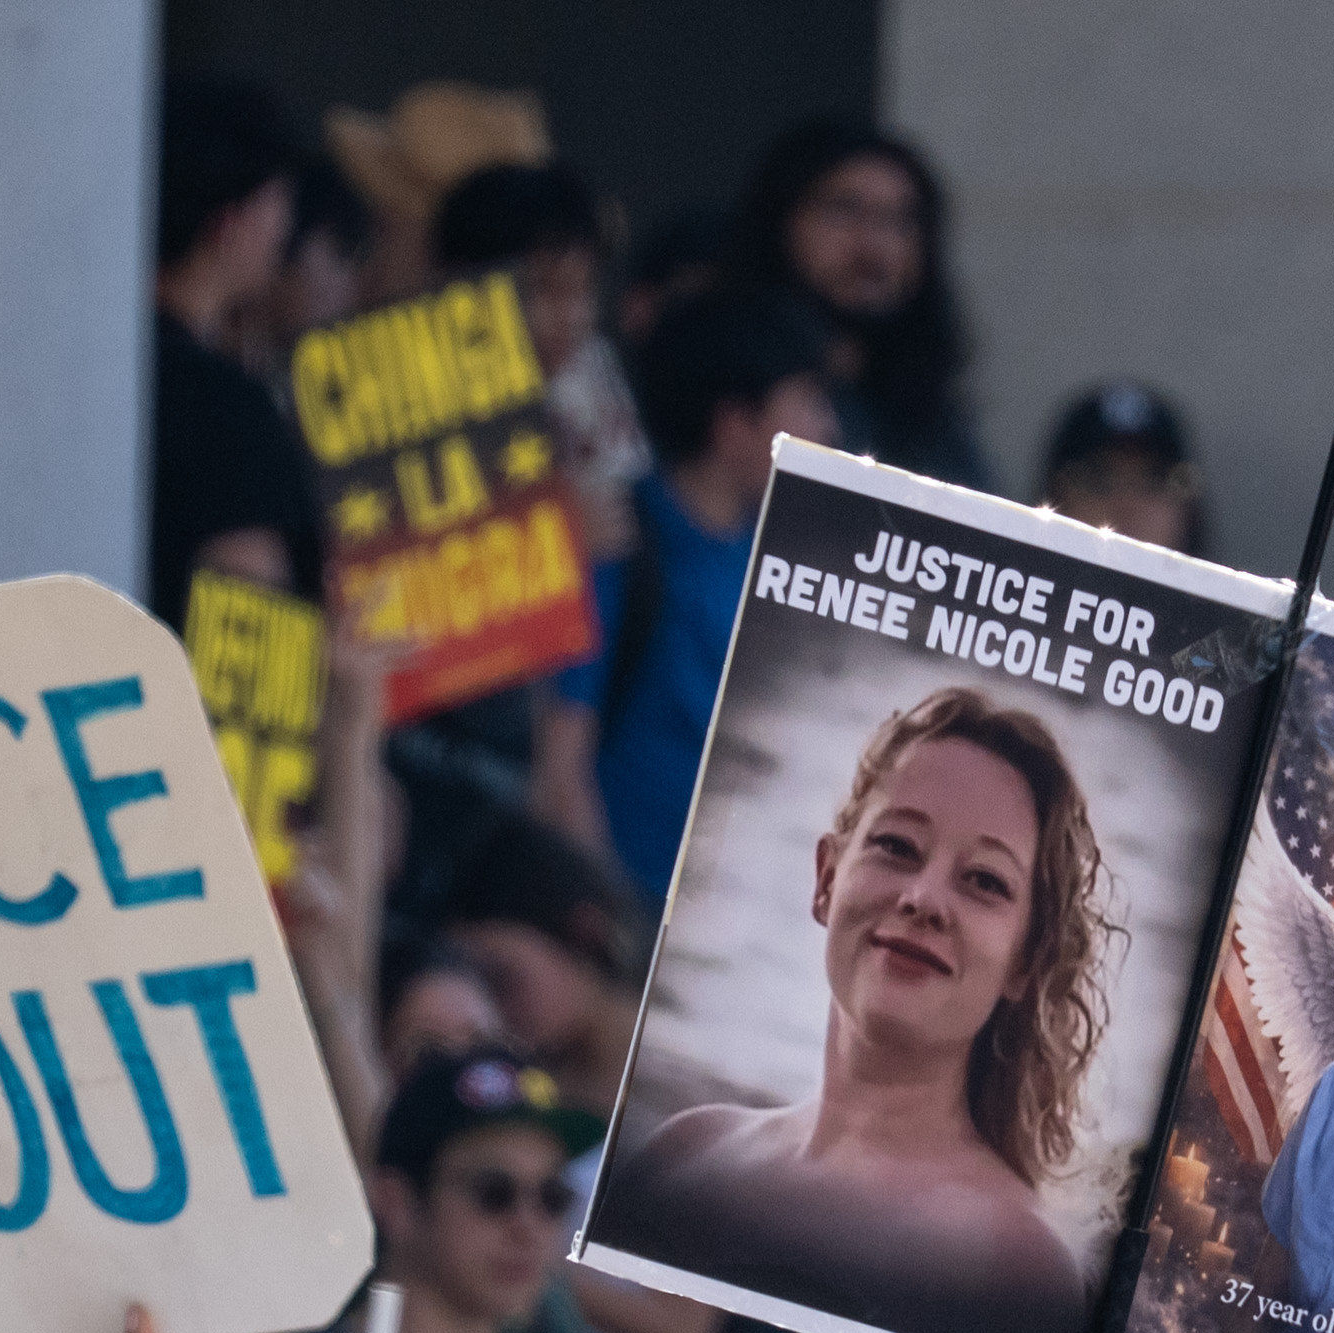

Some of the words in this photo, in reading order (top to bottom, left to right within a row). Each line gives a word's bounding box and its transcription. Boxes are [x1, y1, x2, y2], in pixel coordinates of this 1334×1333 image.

[393, 434, 491, 532] LA
[755, 554, 915, 640] RENEE
[926, 606, 1092, 694] NICOLE
[1103, 659, 1225, 733] GOOD
[854, 530, 1055, 624] JUSTICE
[1065, 591, 1156, 656] FOR
[1220, 1279, 1254, 1308] 37
[1253, 1294, 1309, 1327] year
